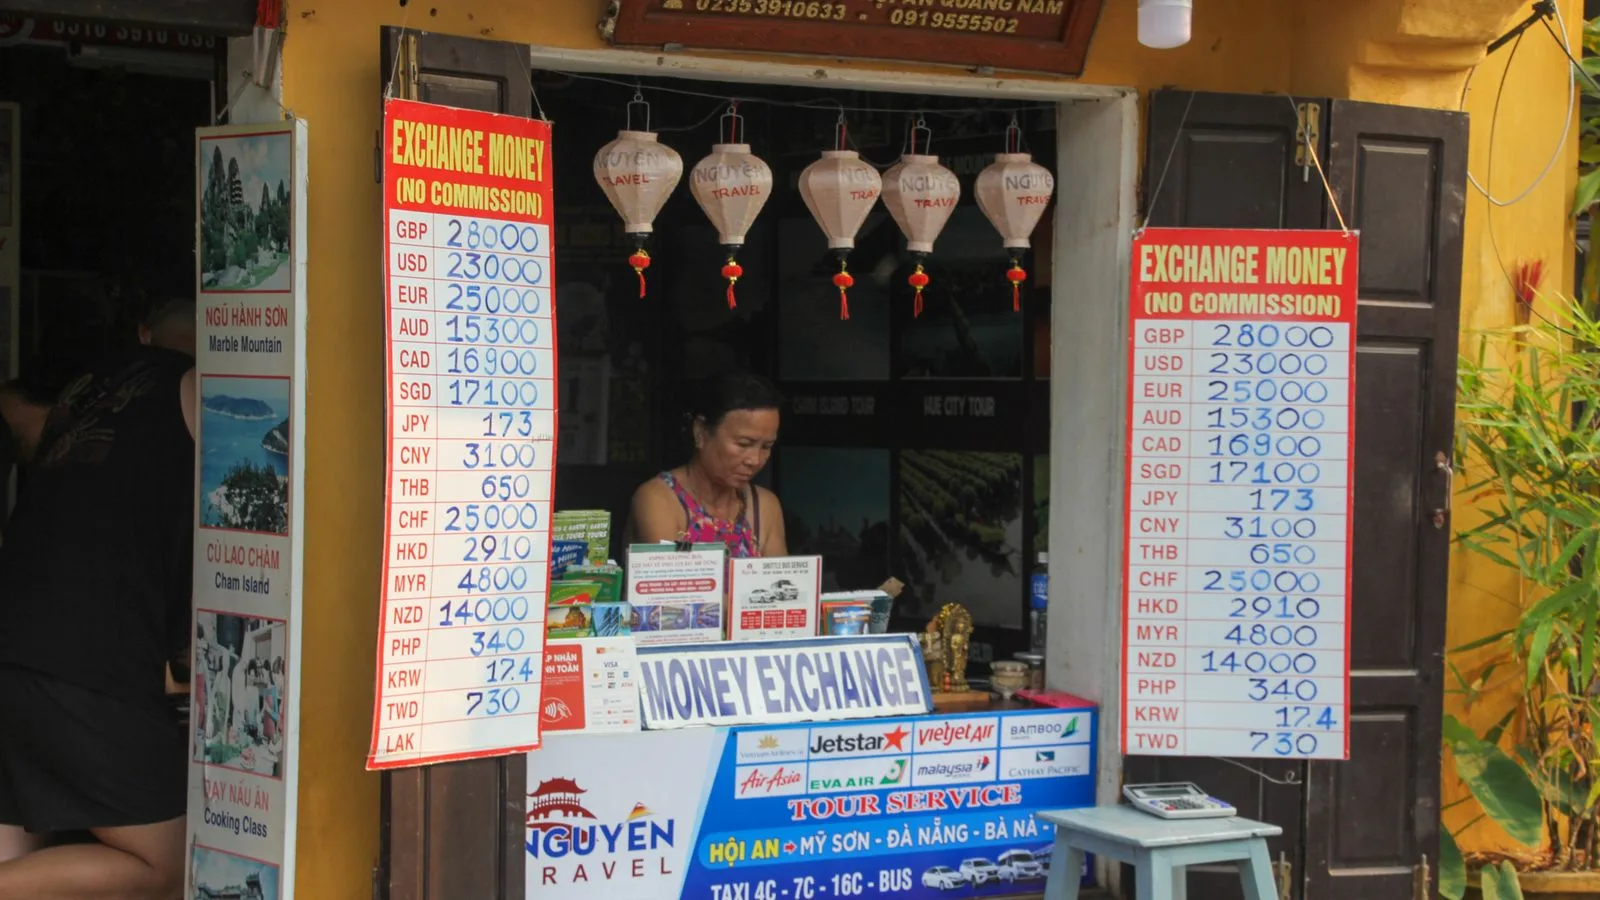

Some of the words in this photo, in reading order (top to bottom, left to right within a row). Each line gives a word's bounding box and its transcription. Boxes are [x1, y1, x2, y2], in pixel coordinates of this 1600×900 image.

[890, 9, 1019, 33] 0919555502
[392, 119, 484, 174] EXCHANGE
[488, 132, 544, 182] MONEY
[396, 177, 426, 204] (NO
[431, 183, 543, 219] COMMISSION)
[712, 184, 760, 200] TRAVEL
[396, 220, 428, 241] GBP
[447, 219, 539, 252] 28000
[397, 253, 428, 273] USD
[446, 251, 542, 285] 23000
[1140, 244, 1260, 284] EXCHANGE
[1266, 246, 1347, 285] MONEY
[398, 285, 428, 304] EUR
[446, 283, 540, 314] 25000
[1144, 292, 1182, 315] (NO
[1189, 292, 1341, 318] COMMISSION)
[399, 318, 429, 337] AUD
[446, 314, 538, 345] 15300
[1144, 328, 1185, 343] GBP
[1212, 324, 1334, 348] 28000
[209, 335, 239, 352] Marble
[241, 335, 282, 353] Mountain
[399, 350, 430, 369] CAD
[448, 347, 537, 377] 16900
[1144, 355, 1183, 371] USD
[1208, 352, 1328, 376] 23000
[399, 382, 431, 401] SGD
[449, 379, 538, 406] 17100
[1144, 383, 1182, 398] EUR
[1208, 379, 1328, 403] 25000
[944, 397, 965, 416] CITY
[969, 397, 995, 417] TOUR
[1142, 410, 1182, 425] AUD
[1207, 407, 1325, 430] 15300
[402, 414, 429, 432] JPY
[482, 411, 532, 438] 173
[400, 446, 430, 464] CNY
[463, 442, 535, 469] 3100
[1142, 437, 1181, 452] CAD
[1208, 433, 1321, 458] 16900
[1140, 463, 1182, 479] SGD
[1209, 461, 1320, 484] 17100
[400, 479, 429, 496] THB
[481, 474, 530, 501] 650
[1142, 491, 1177, 506] JPY
[1250, 488, 1314, 512] 173
[399, 510, 429, 528] CHF
[444, 502, 538, 532] 25000
[1140, 518, 1180, 533] CNY
[1224, 516, 1316, 539] 3100
[224, 543, 245, 565] LAO
[396, 542, 428, 560] HKD
[463, 535, 531, 562] 2910
[1140, 544, 1179, 560] THB
[1250, 543, 1316, 565] 650
[215, 571, 240, 591] Cham
[243, 574, 270, 594] Island
[394, 574, 426, 593] MYR
[457, 566, 528, 593] 4800
[1139, 571, 1178, 587] CHF
[1203, 569, 1320, 593] 25000
[393, 606, 423, 625] NZD
[439, 596, 529, 627] 14000
[1138, 599, 1179, 614] HKD
[1229, 596, 1320, 619] 2910
[391, 638, 421, 656] PHP
[470, 627, 525, 657] 340
[1137, 625, 1178, 641] MYR
[1225, 624, 1318, 647] 4800
[387, 669, 421, 689] KRW
[486, 656, 533, 683] 17.4
[1138, 653, 1176, 668] NZD
[1201, 650, 1317, 674] 14000
[640, 657, 752, 720] MONEY
[754, 647, 920, 713] EXCHANGE
[1138, 679, 1176, 694] PHP
[1248, 677, 1318, 702] 340
[387, 701, 418, 721] TWD
[466, 686, 520, 715] 730
[1010, 723, 1061, 736] BAMBOO
[1135, 706, 1179, 722] KRW
[1275, 705, 1337, 731] 17.4
[386, 732, 415, 754] LAK
[810, 733, 884, 754] Jetstar
[1135, 733, 1179, 749] TWD
[1250, 731, 1318, 756] 730
[917, 763, 973, 776] malaysia
[810, 778, 842, 790] EVA
[845, 776, 874, 787] AIR
[789, 794, 880, 820] TOUR
[886, 784, 1022, 813] SERVICE
[204, 806, 240, 835] Cooking
[243, 815, 267, 838] Class
[709, 837, 745, 867] HỘI
[751, 838, 779, 860] AN
[800, 829, 827, 855] MỸ
[832, 830, 870, 853] SƠN
[887, 823, 913, 848] ĐÀ
[918, 817, 968, 845] NẴNG
[984, 816, 1008, 840] BÀ
[1013, 814, 1038, 838] NÀ
[542, 857, 672, 885] RAVEL
[711, 882, 749, 900] TAXI
[754, 880, 777, 900] 4C
[794, 876, 814, 900] 7C
[831, 872, 863, 896] 16C
[879, 868, 912, 892] BUS
